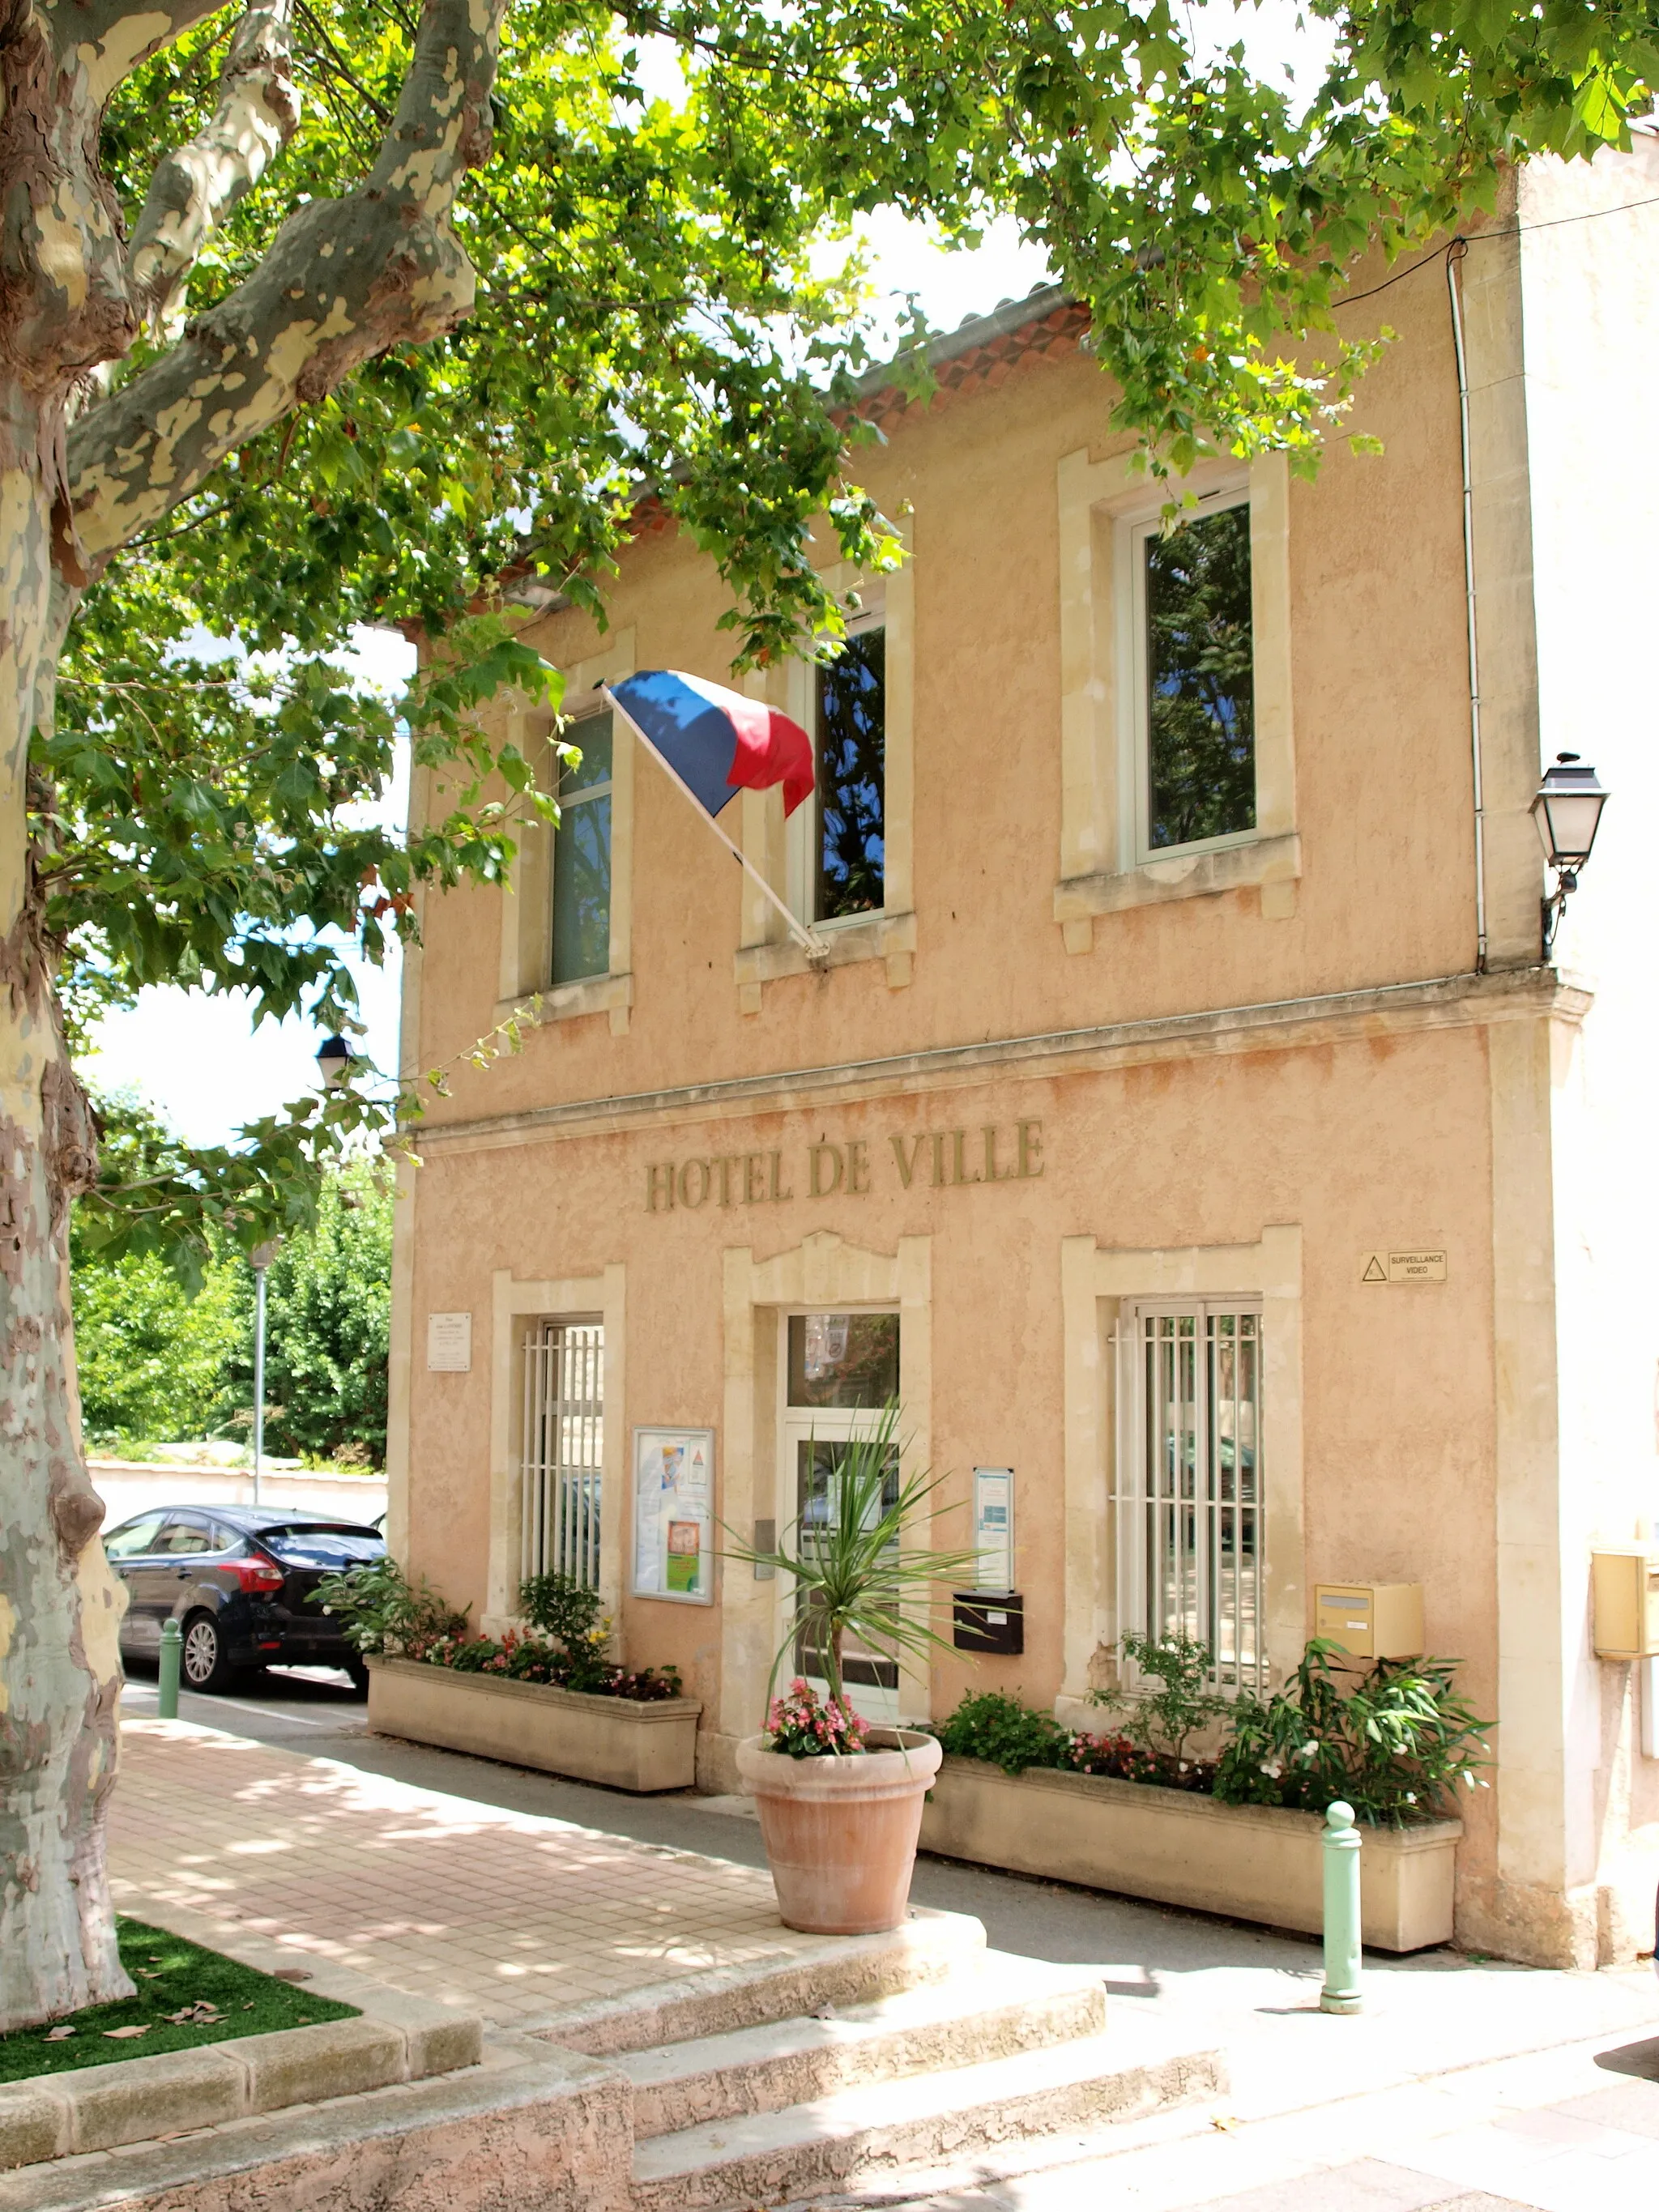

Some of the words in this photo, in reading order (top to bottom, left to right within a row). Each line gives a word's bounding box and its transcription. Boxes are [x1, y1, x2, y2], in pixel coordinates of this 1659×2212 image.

[644, 1150, 793, 1213] HOTEL
[806, 1140, 871, 1198] DE
[889, 1119, 1045, 1189] VILLE
[1391, 1255, 1444, 1264] SURVEILLANCE
[1406, 1266, 1428, 1274] VIDEO
